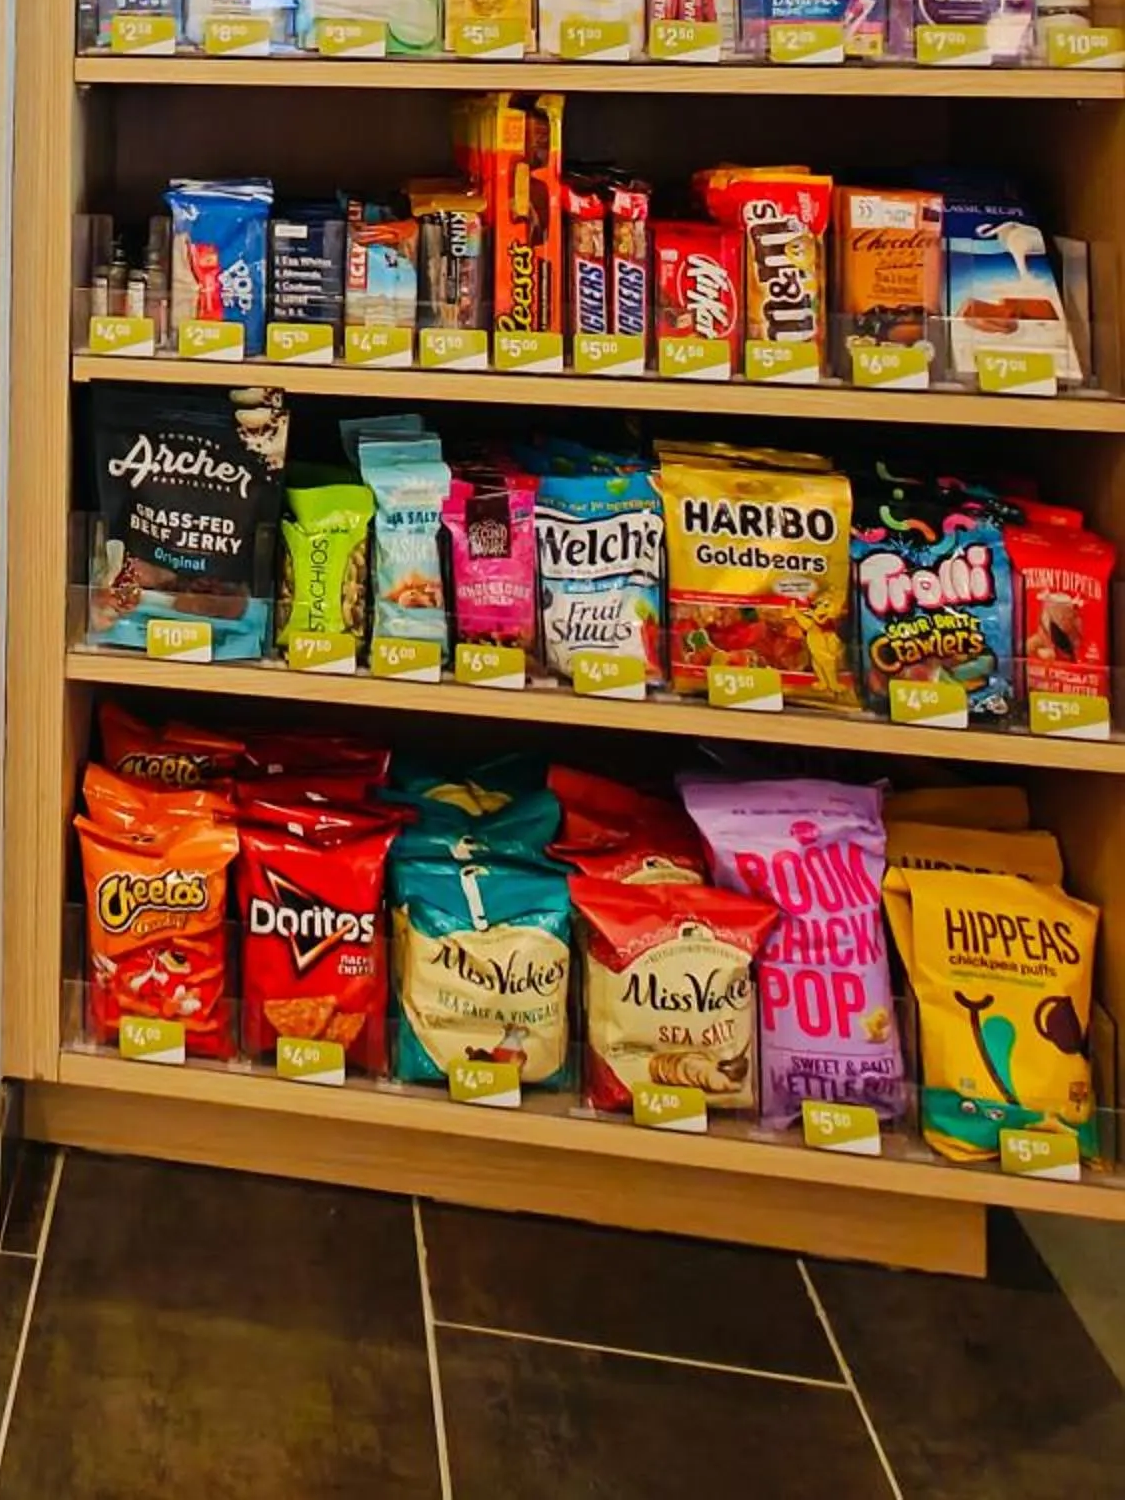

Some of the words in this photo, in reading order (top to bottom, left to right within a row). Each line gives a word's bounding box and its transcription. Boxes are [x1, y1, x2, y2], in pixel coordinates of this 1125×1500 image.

[451, 211, 468, 257] KIND
[577, 259, 606, 334] ICKERS
[615, 259, 644, 336] ICKERS
[108, 433, 253, 499] Archer
[129, 513, 172, 543] BEEF
[176, 530, 243, 556] JERKY
[135, 503, 236, 536] GRASS-FED
[683, 498, 837, 543] HARIBO
[153, 547, 207, 572] Original
[535, 521, 659, 567] Welch's
[696, 543, 827, 574] Goldbears
[308, 537, 330, 633] STACHIOS
[859, 545, 991, 616] Trolli
[568, 599, 623, 622] Fruit
[887, 617, 930, 638] SOUR
[870, 628, 985, 674] Crawlers
[100, 873, 206, 929] Cheetos
[250, 898, 375, 943] Doritos
[944, 907, 1081, 966] HIPPEAS
[430, 943, 496, 991] Miss
[487, 949, 567, 997] Vickie's
[948, 954, 1017, 973] chickpea
[1020, 962, 1057, 978] puffs
[437, 988, 459, 1013] SEA
[621, 972, 693, 1013] Miss
[759, 966, 867, 1039] POP
[658, 1024, 693, 1046] SEA
[702, 1019, 736, 1046] SALT
[790, 1056, 840, 1076] SWEET
[845, 1060, 857, 1076] &
